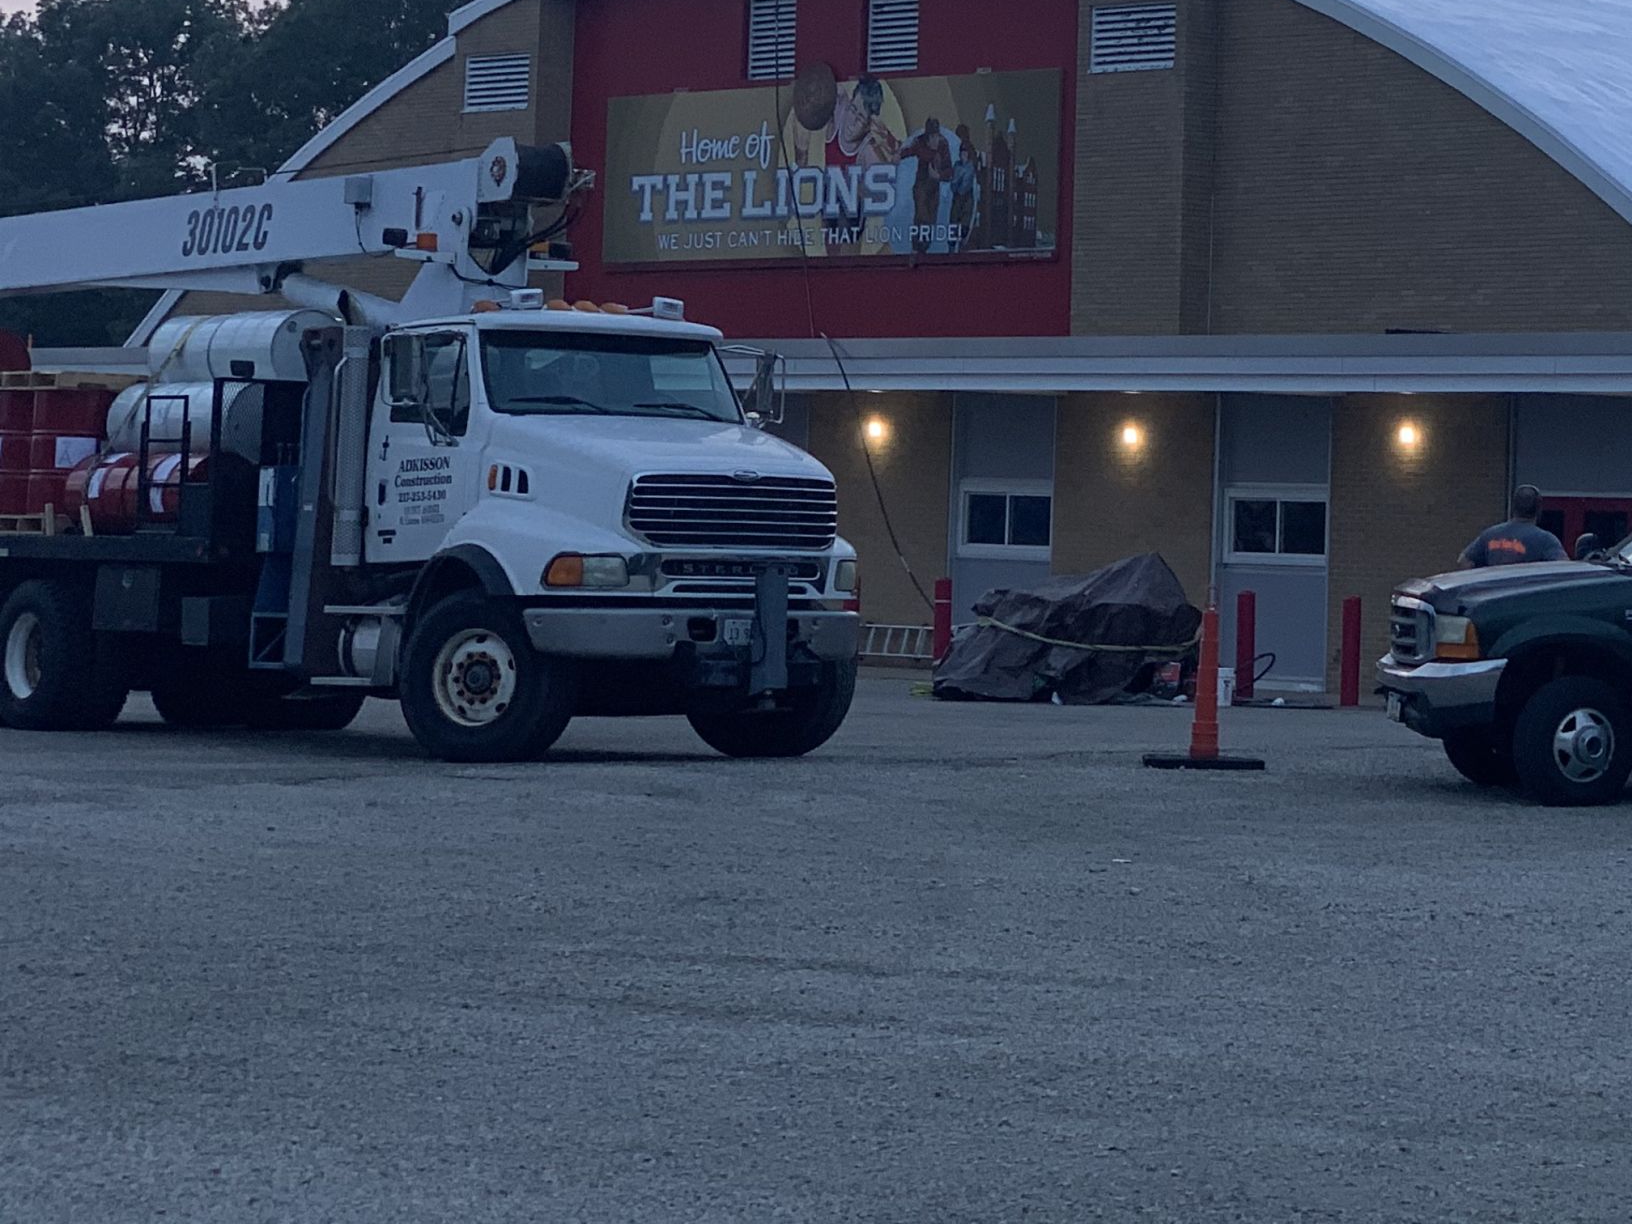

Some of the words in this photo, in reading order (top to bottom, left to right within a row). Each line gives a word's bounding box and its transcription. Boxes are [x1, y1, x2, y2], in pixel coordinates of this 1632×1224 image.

[680, 129, 741, 164] Home
[745, 121, 775, 169] of
[630, 171, 732, 222] THE
[741, 163, 898, 218] LIONS
[182, 203, 273, 257] 30102C
[658, 233, 680, 250] WE
[683, 231, 722, 249] JUST
[728, 230, 771, 248] CAN'T
[820, 226, 861, 245] THAT
[865, 226, 902, 244] LION
[908, 224, 963, 242] PRIDE!
[394, 473, 453, 489] Construction
[400, 456, 451, 473] ADKISSON
